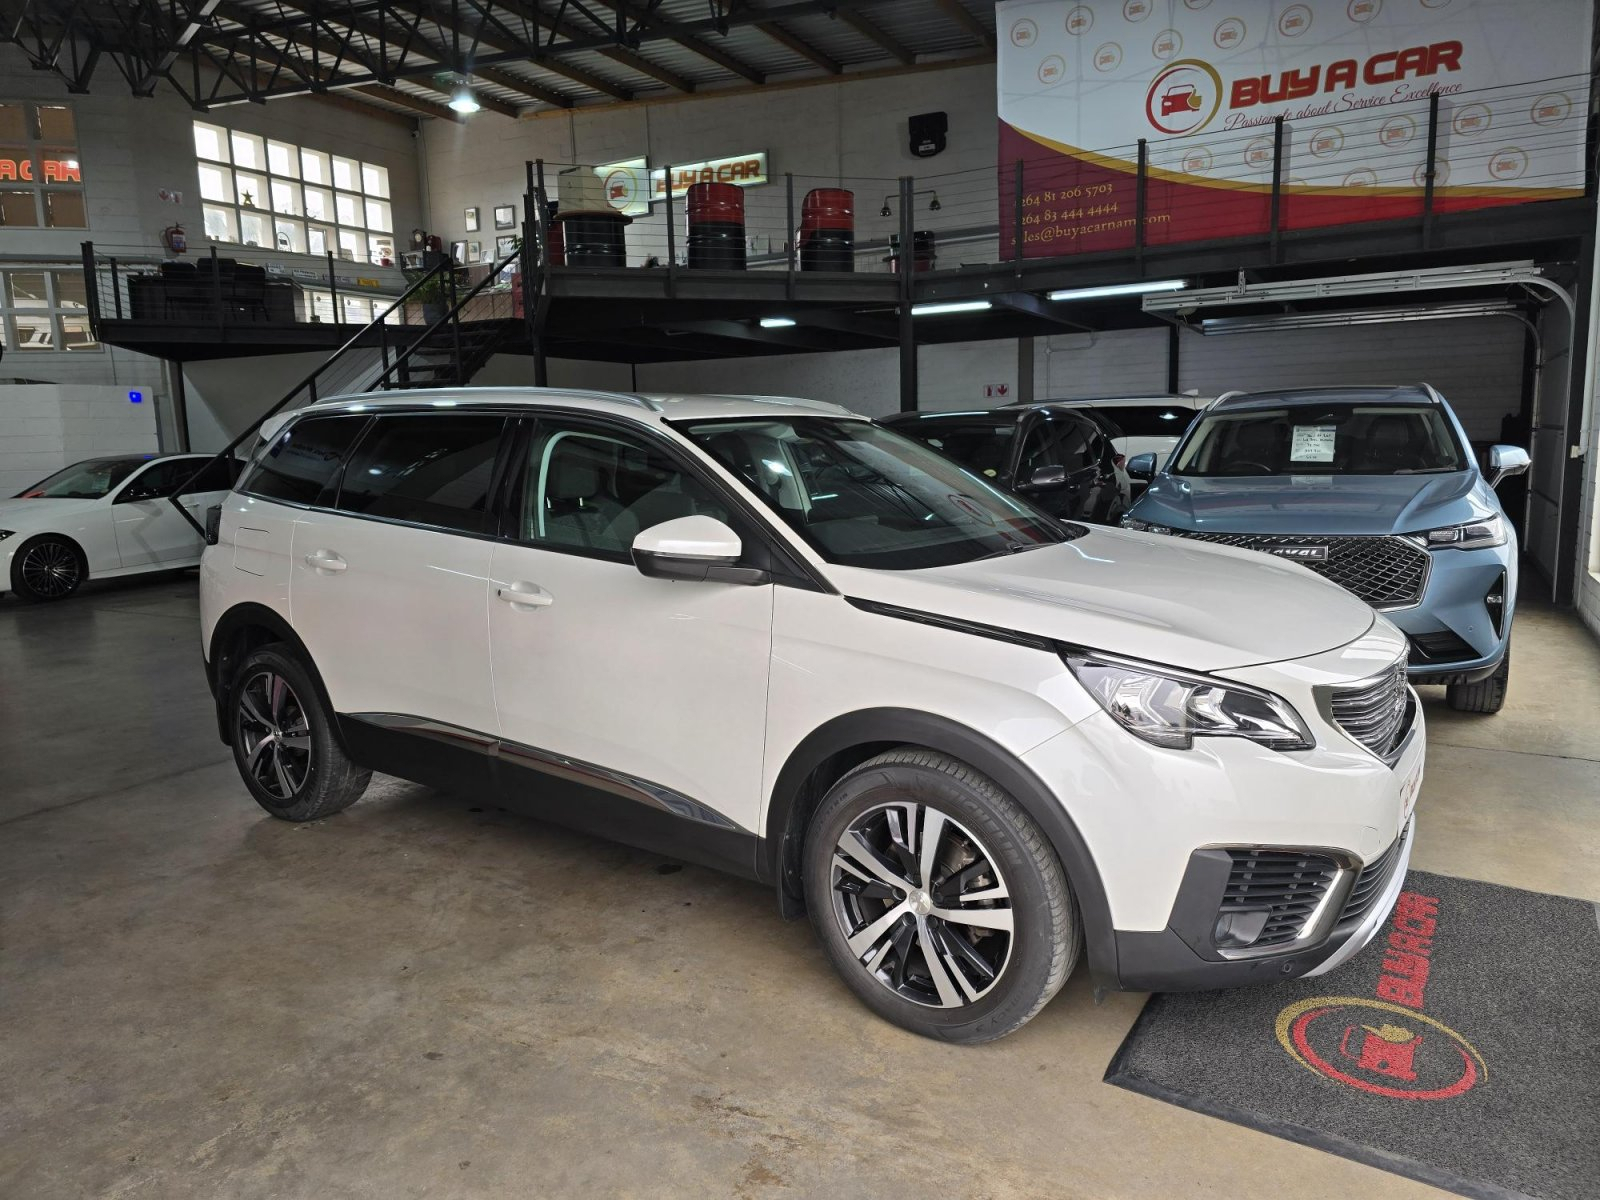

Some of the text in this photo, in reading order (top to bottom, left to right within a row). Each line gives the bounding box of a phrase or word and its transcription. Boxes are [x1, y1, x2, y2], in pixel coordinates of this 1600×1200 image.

[1229, 40, 1463, 109] BUY A CAR
[1223, 81, 1463, 131] Passionte about Service Excellence
[0, 159, 81, 182] A CAR
[700, 167, 714, 183] A
[717, 159, 760, 183] CAR
[1014, 183, 1113, 207] 264 81 206 5703
[1013, 202, 1118, 226] 264 83 444 4444
[1010, 214, 1171, 246] sles@buyacarnamcom
